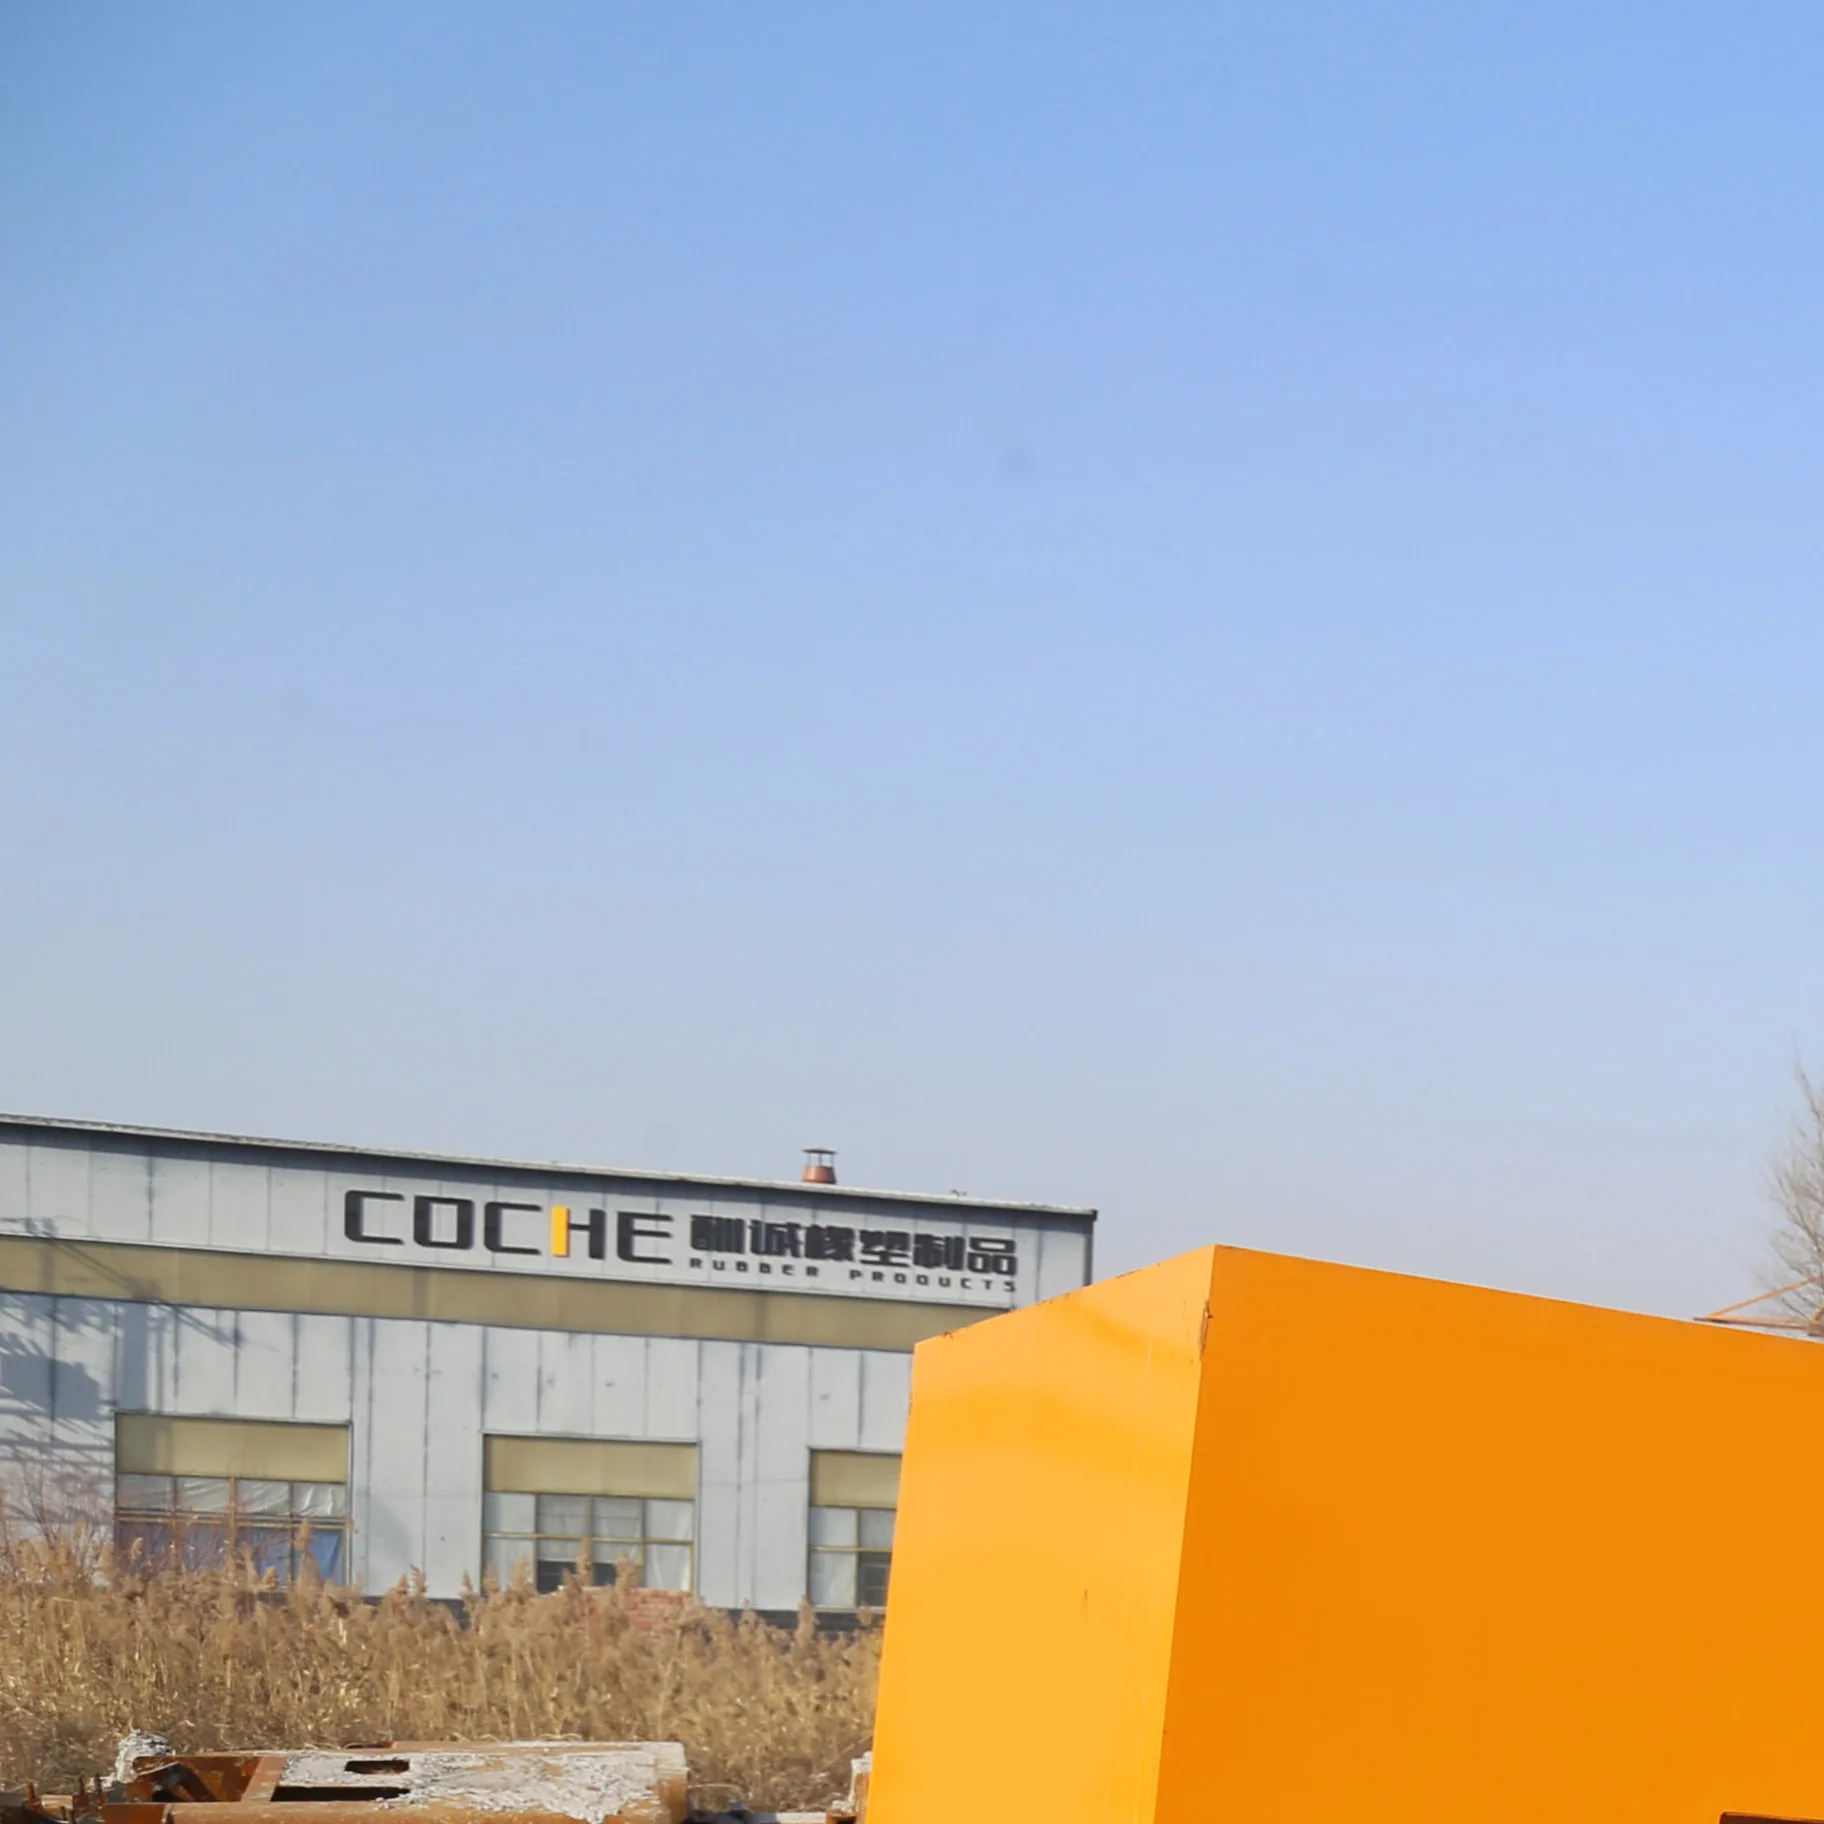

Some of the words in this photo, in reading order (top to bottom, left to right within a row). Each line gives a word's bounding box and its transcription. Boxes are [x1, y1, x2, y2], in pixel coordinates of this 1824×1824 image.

[343, 1189, 674, 1265] COCHE
[689, 1257, 820, 1277] RUBBER
[849, 1269, 1016, 1292] PRODUCTS
